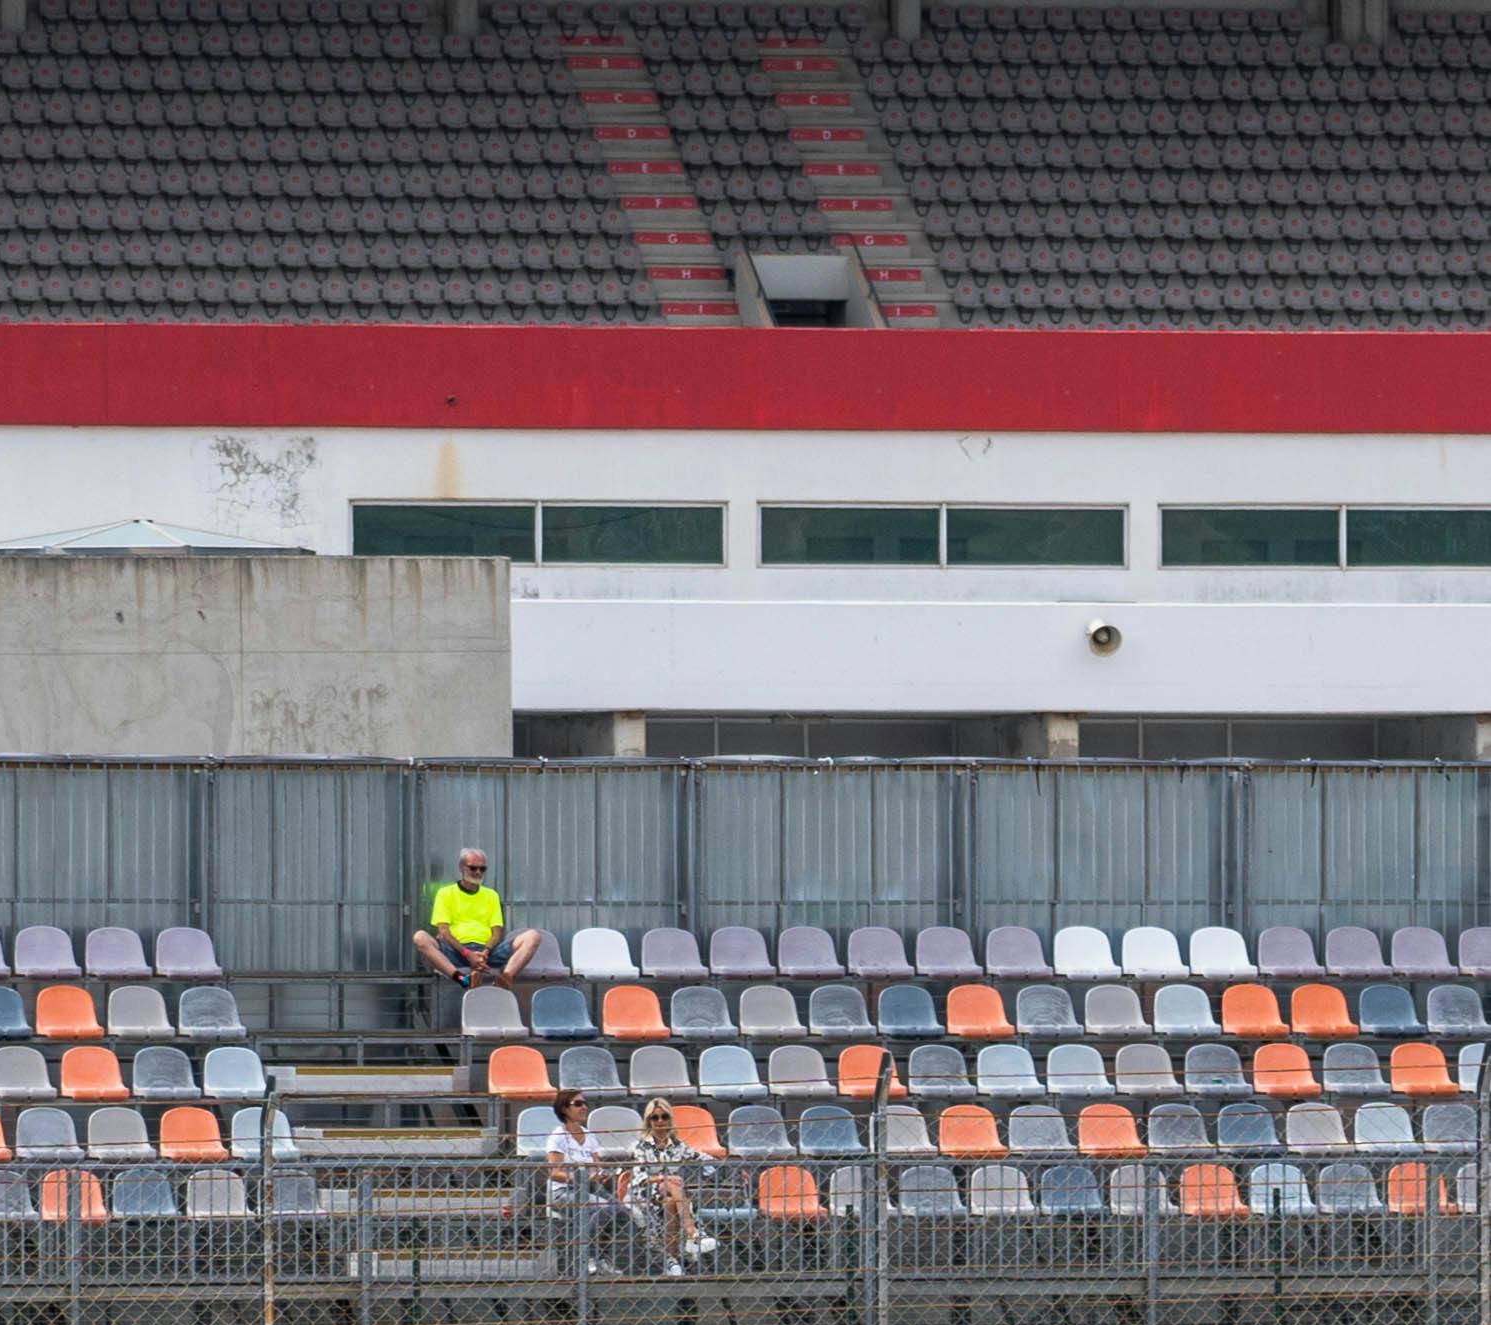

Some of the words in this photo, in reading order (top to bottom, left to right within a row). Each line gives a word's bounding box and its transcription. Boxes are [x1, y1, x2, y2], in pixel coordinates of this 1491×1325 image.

[809, 94, 818, 105] C
[627, 128, 637, 138] D
[822, 130, 831, 141] D
[668, 233, 678, 244] G
[864, 235, 874, 245] G
[681, 269, 691, 279] H
[879, 270, 889, 280] H
